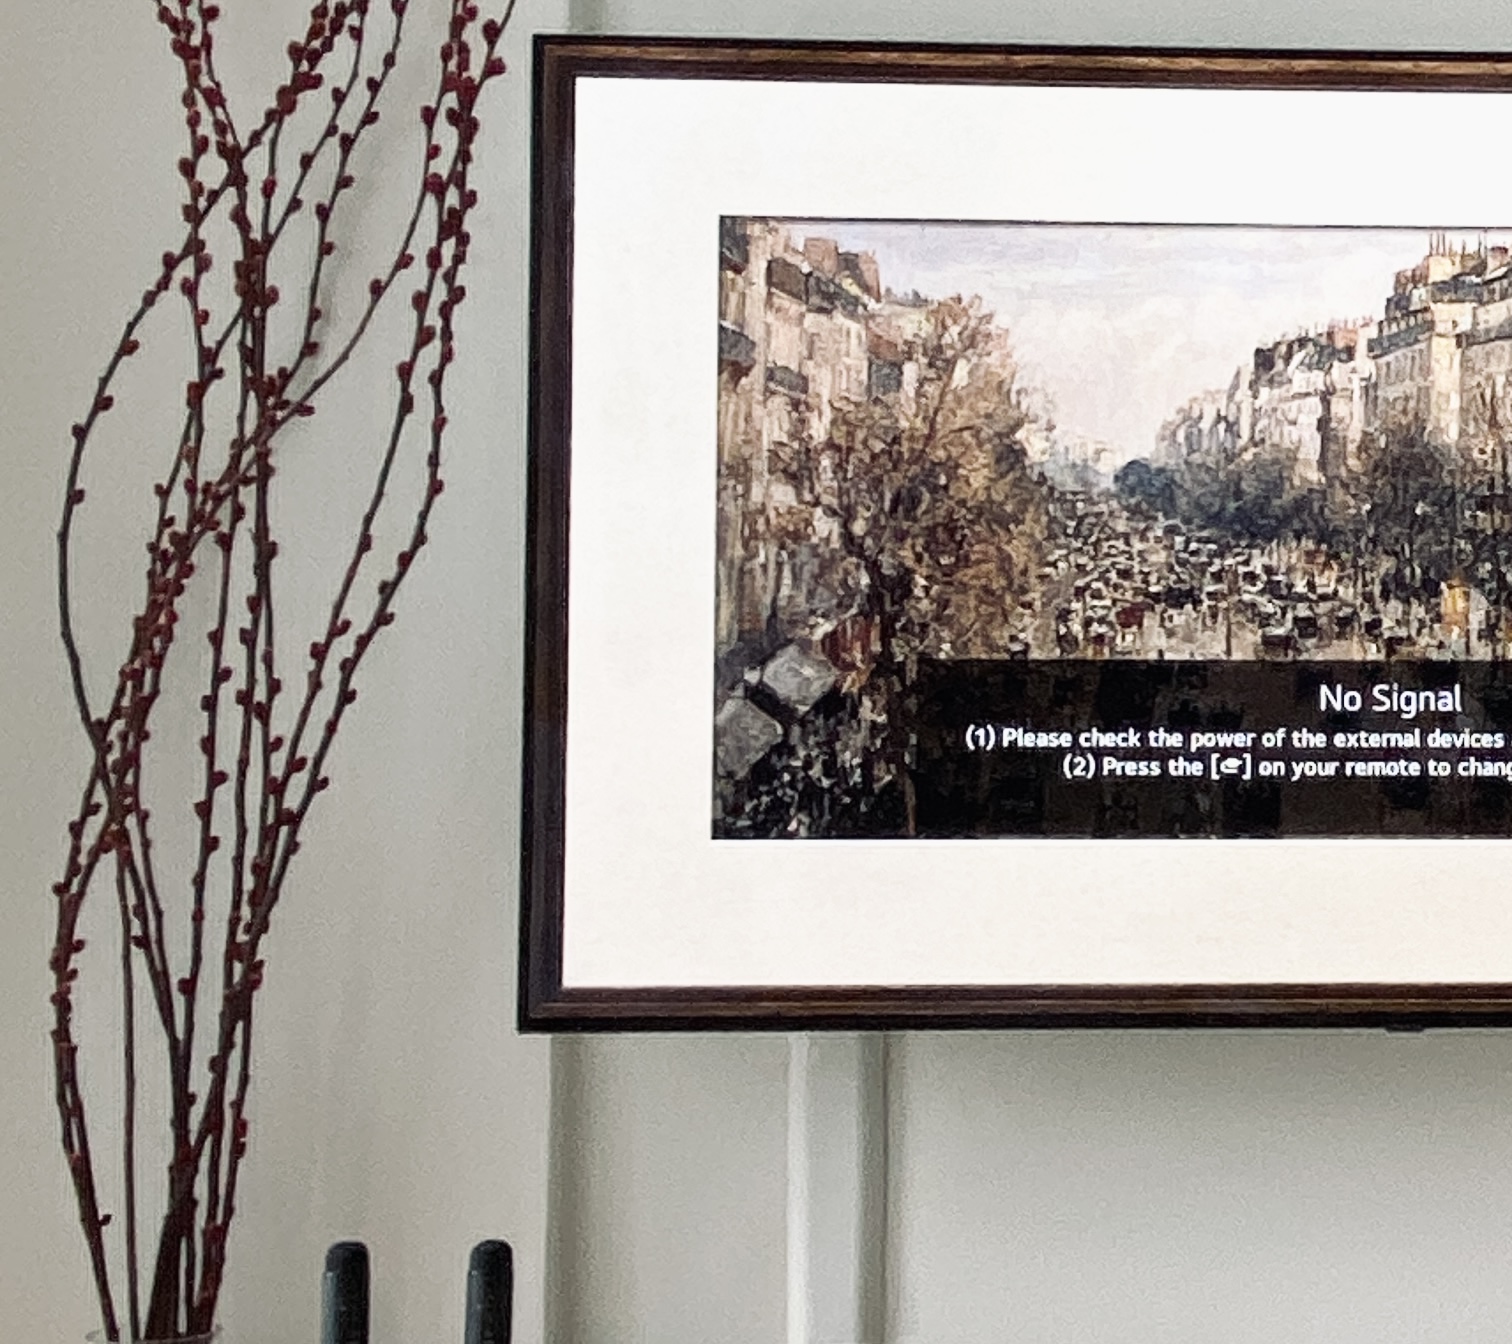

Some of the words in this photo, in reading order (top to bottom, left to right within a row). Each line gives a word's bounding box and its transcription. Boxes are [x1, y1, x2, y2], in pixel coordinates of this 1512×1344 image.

[1319, 683, 1362, 712] No
[1371, 682, 1463, 719] Signal
[965, 723, 996, 752] (1)
[1001, 726, 1073, 748] Please
[1078, 726, 1142, 748] check
[1147, 726, 1184, 748] the
[1189, 732, 1257, 753] power
[1261, 727, 1287, 748] of
[1290, 727, 1328, 749] the
[1332, 727, 1421, 749] external
[1426, 727, 1506, 749] devices
[1062, 754, 1096, 780] (2)
[1101, 756, 1162, 777] Press
[1167, 755, 1204, 777] the
[1258, 760, 1286, 777] on
[1290, 761, 1341, 782] your
[1344, 758, 1421, 777] remote
[1427, 757, 1452, 777] to
